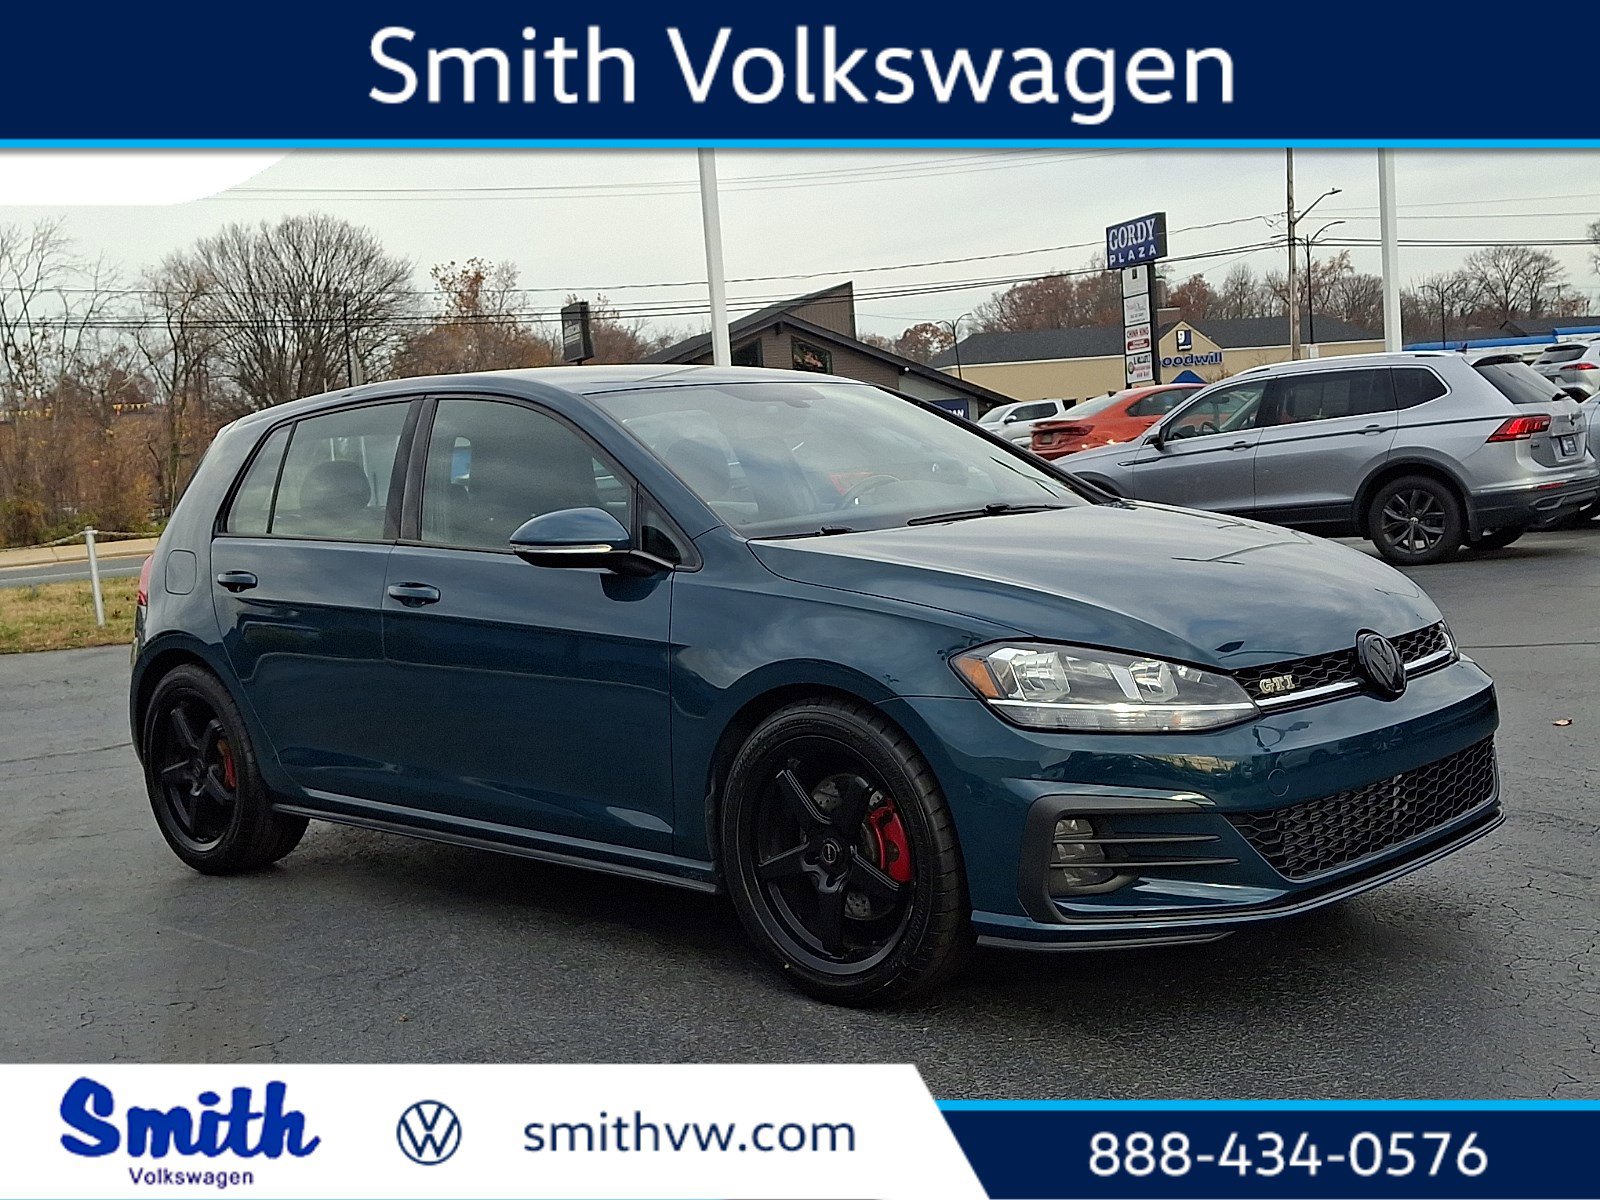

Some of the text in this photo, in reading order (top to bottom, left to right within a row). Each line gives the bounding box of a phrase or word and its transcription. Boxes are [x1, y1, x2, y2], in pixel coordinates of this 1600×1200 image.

[1109, 217, 1156, 251] GORDY
[1109, 244, 1157, 266] PLAZA
[1159, 351, 1222, 368] oodwill
[1260, 675, 1295, 694] GTI
